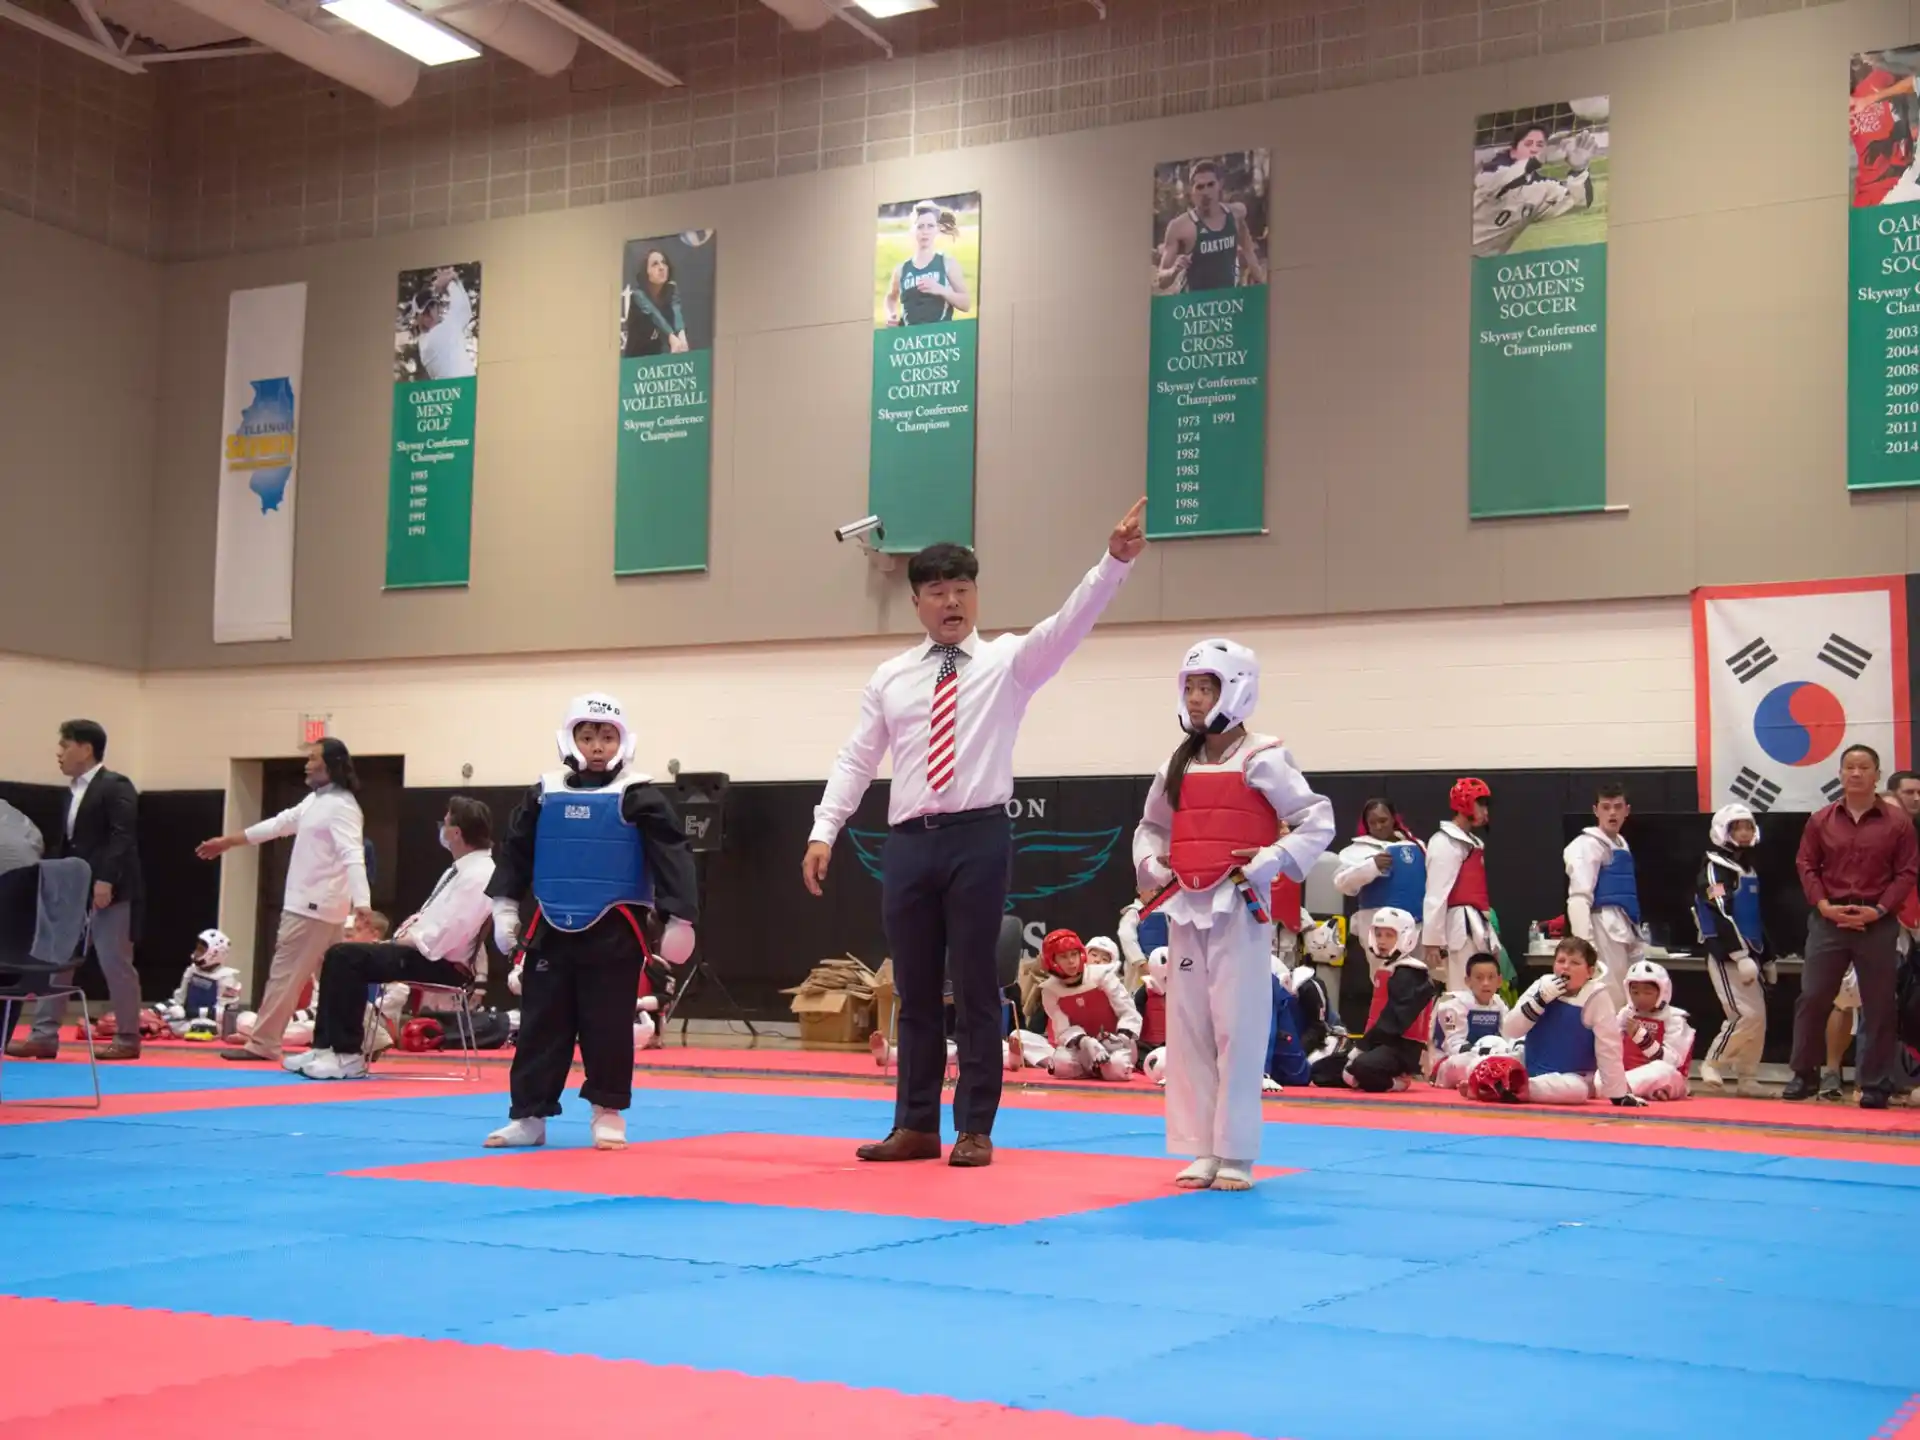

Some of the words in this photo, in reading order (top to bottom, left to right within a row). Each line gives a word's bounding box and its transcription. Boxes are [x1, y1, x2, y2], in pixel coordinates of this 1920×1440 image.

[1200, 236, 1236, 254] OAKTON
[1496, 258, 1580, 283] OAKTON
[1492, 276, 1585, 302] WOMEN'S
[1857, 286, 1911, 303] Skyway
[1172, 298, 1245, 321] OAKTON
[1499, 296, 1578, 319] SOCCER
[1182, 317, 1234, 337] MEN'S
[1479, 330, 1525, 346] Skyway
[1527, 323, 1598, 338] Conference
[1885, 325, 1919, 340] 2003
[893, 331, 957, 352] OAKTON
[1181, 334, 1235, 353] CROSS
[1503, 341, 1573, 357] Champions
[888, 347, 961, 368] WOMEN'S
[1885, 344, 1920, 359] 2004
[1167, 350, 1249, 372] COUNTRY
[637, 361, 695, 381] OAKTON
[900, 364, 949, 383] CROSS
[1885, 363, 1920, 378] 2008
[633, 376, 697, 396] WOMEN'S
[887, 379, 961, 401] COUNTRY
[1156, 381, 1196, 396] Skyway
[1197, 375, 1259, 390] Conference
[1885, 382, 1919, 397] 2009
[408, 387, 462, 405] OAKTON
[622, 391, 707, 412] VOLLEYBALL
[1176, 392, 1237, 407] Champions
[416, 402, 453, 419] MEN'S
[877, 408, 914, 422] Skyway
[915, 403, 969, 417] Conference
[1885, 401, 1920, 416] 2010
[416, 417, 452, 433] GOLF
[623, 419, 655, 433] Skyway
[656, 414, 705, 427] Conference
[895, 418, 951, 434] Champions
[1177, 415, 1201, 428] 1973
[1212, 412, 1236, 425] 1991
[1885, 421, 1918, 435] 2011
[426, 436, 470, 449] Conference
[639, 428, 688, 443] Champions
[1176, 431, 1200, 444] 1974
[1176, 447, 1200, 460] 1982
[1885, 440, 1920, 454] 2014
[410, 450, 455, 464] Champions
[1176, 464, 1200, 477] 1983
[1175, 481, 1200, 494] 1984
[1175, 498, 1200, 511] 1986
[1174, 514, 1200, 527] 1987
[1004, 798, 1047, 819] ON
